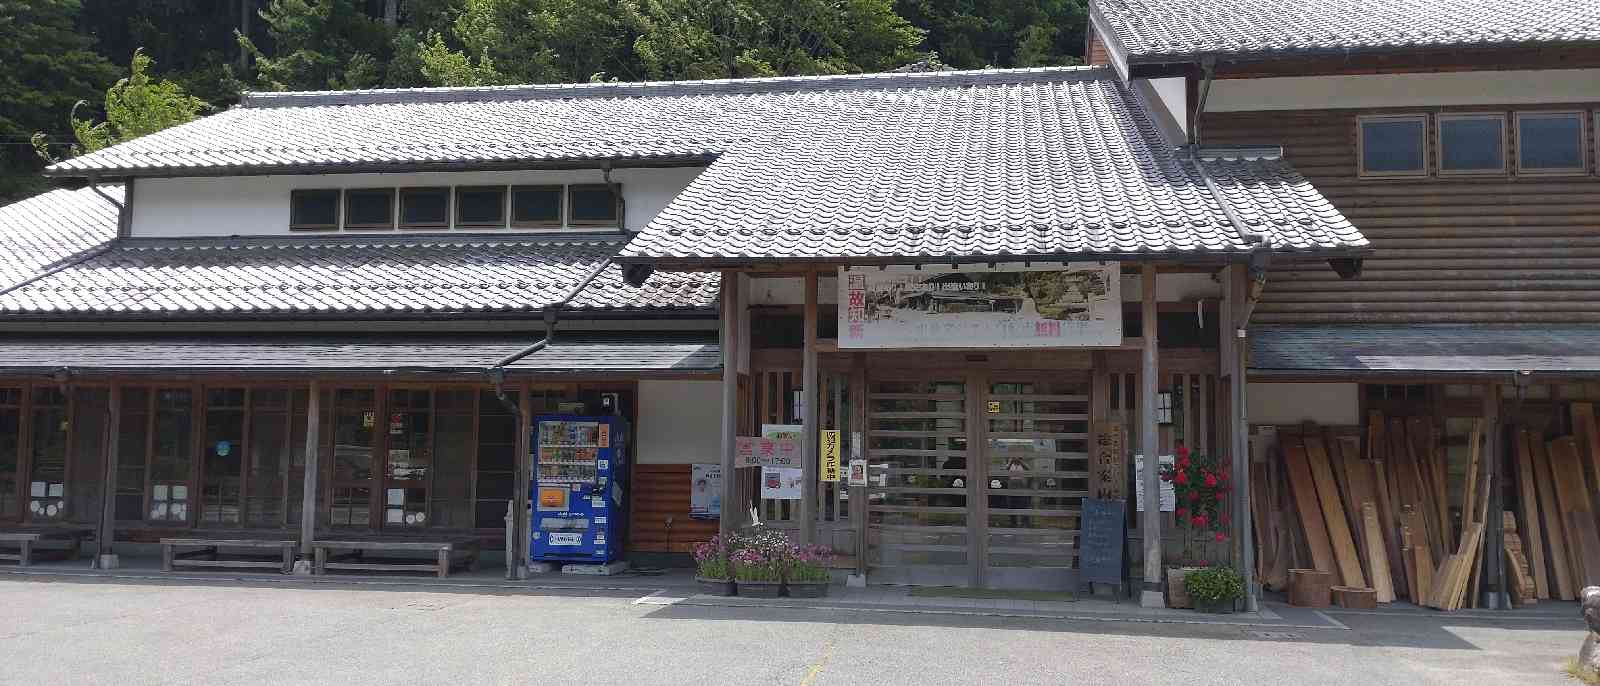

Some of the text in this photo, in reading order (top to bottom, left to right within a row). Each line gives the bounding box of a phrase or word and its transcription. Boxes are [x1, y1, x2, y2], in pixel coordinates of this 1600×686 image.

[847, 274, 865, 339] 温故知新
[737, 439, 794, 455] 営業中
